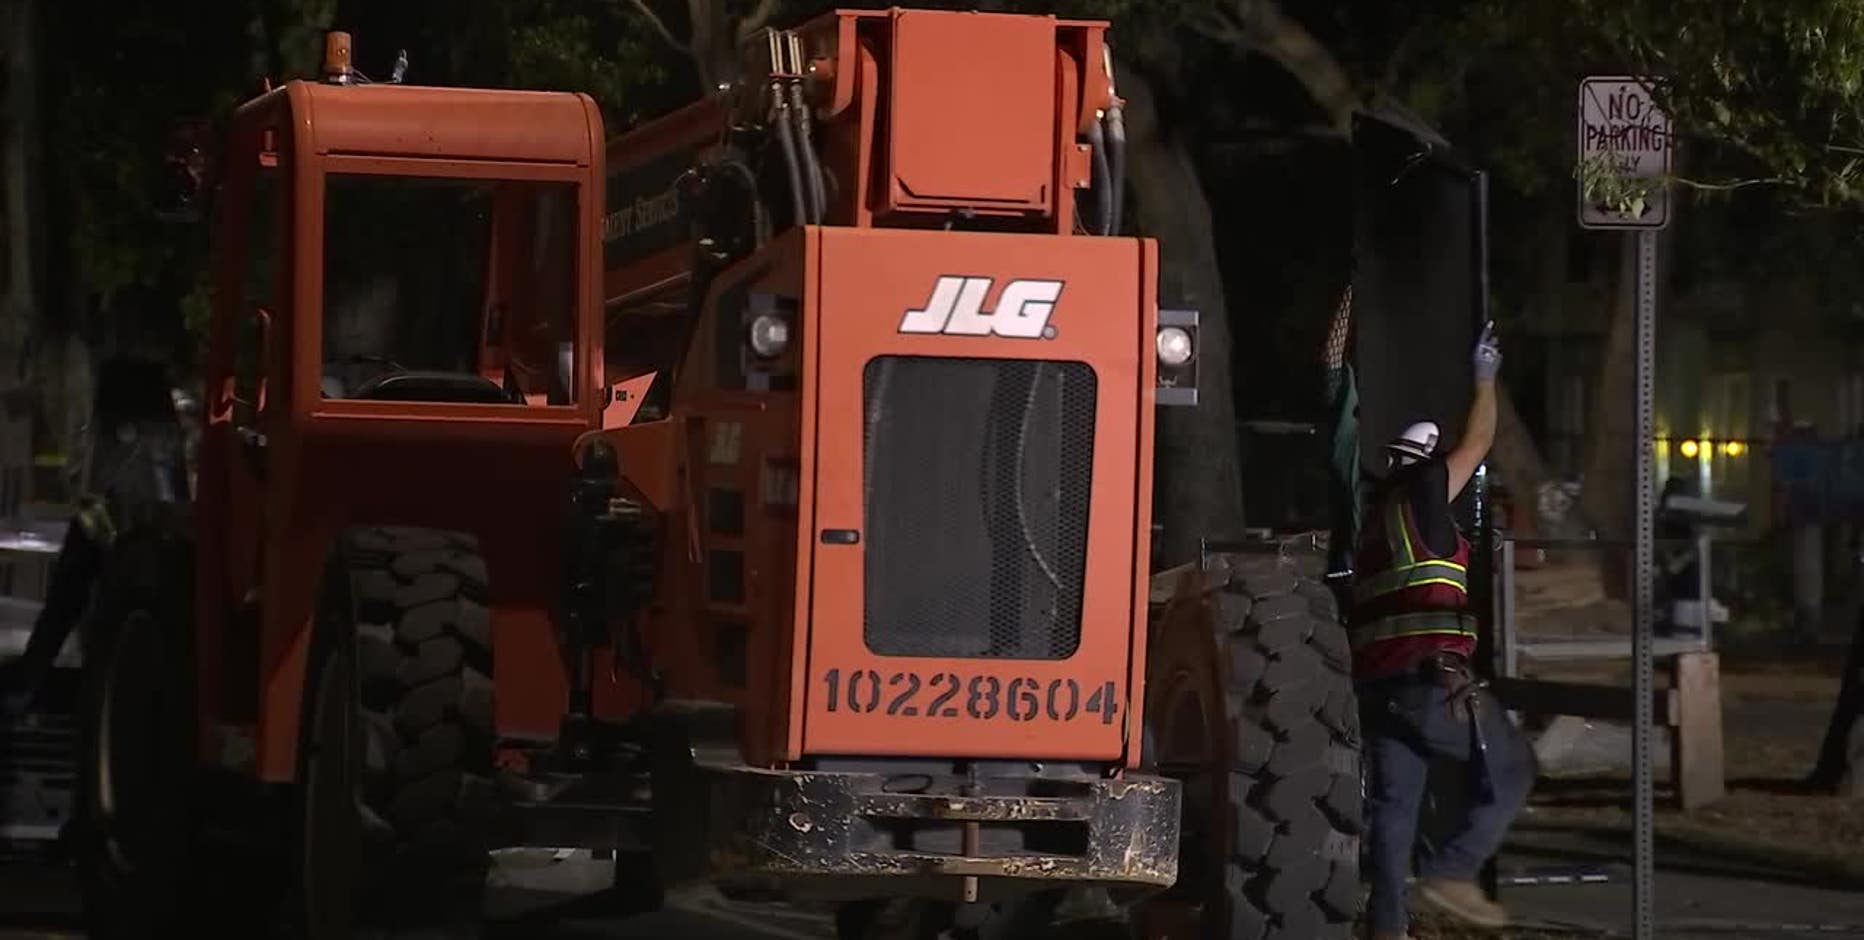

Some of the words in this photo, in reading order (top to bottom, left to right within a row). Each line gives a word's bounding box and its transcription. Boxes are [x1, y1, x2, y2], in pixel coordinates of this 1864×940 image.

[1609, 93, 1641, 120] NO
[1586, 124, 1663, 151] PARKING
[898, 275, 1066, 339] JLG
[824, 668, 1118, 724] 10228604
